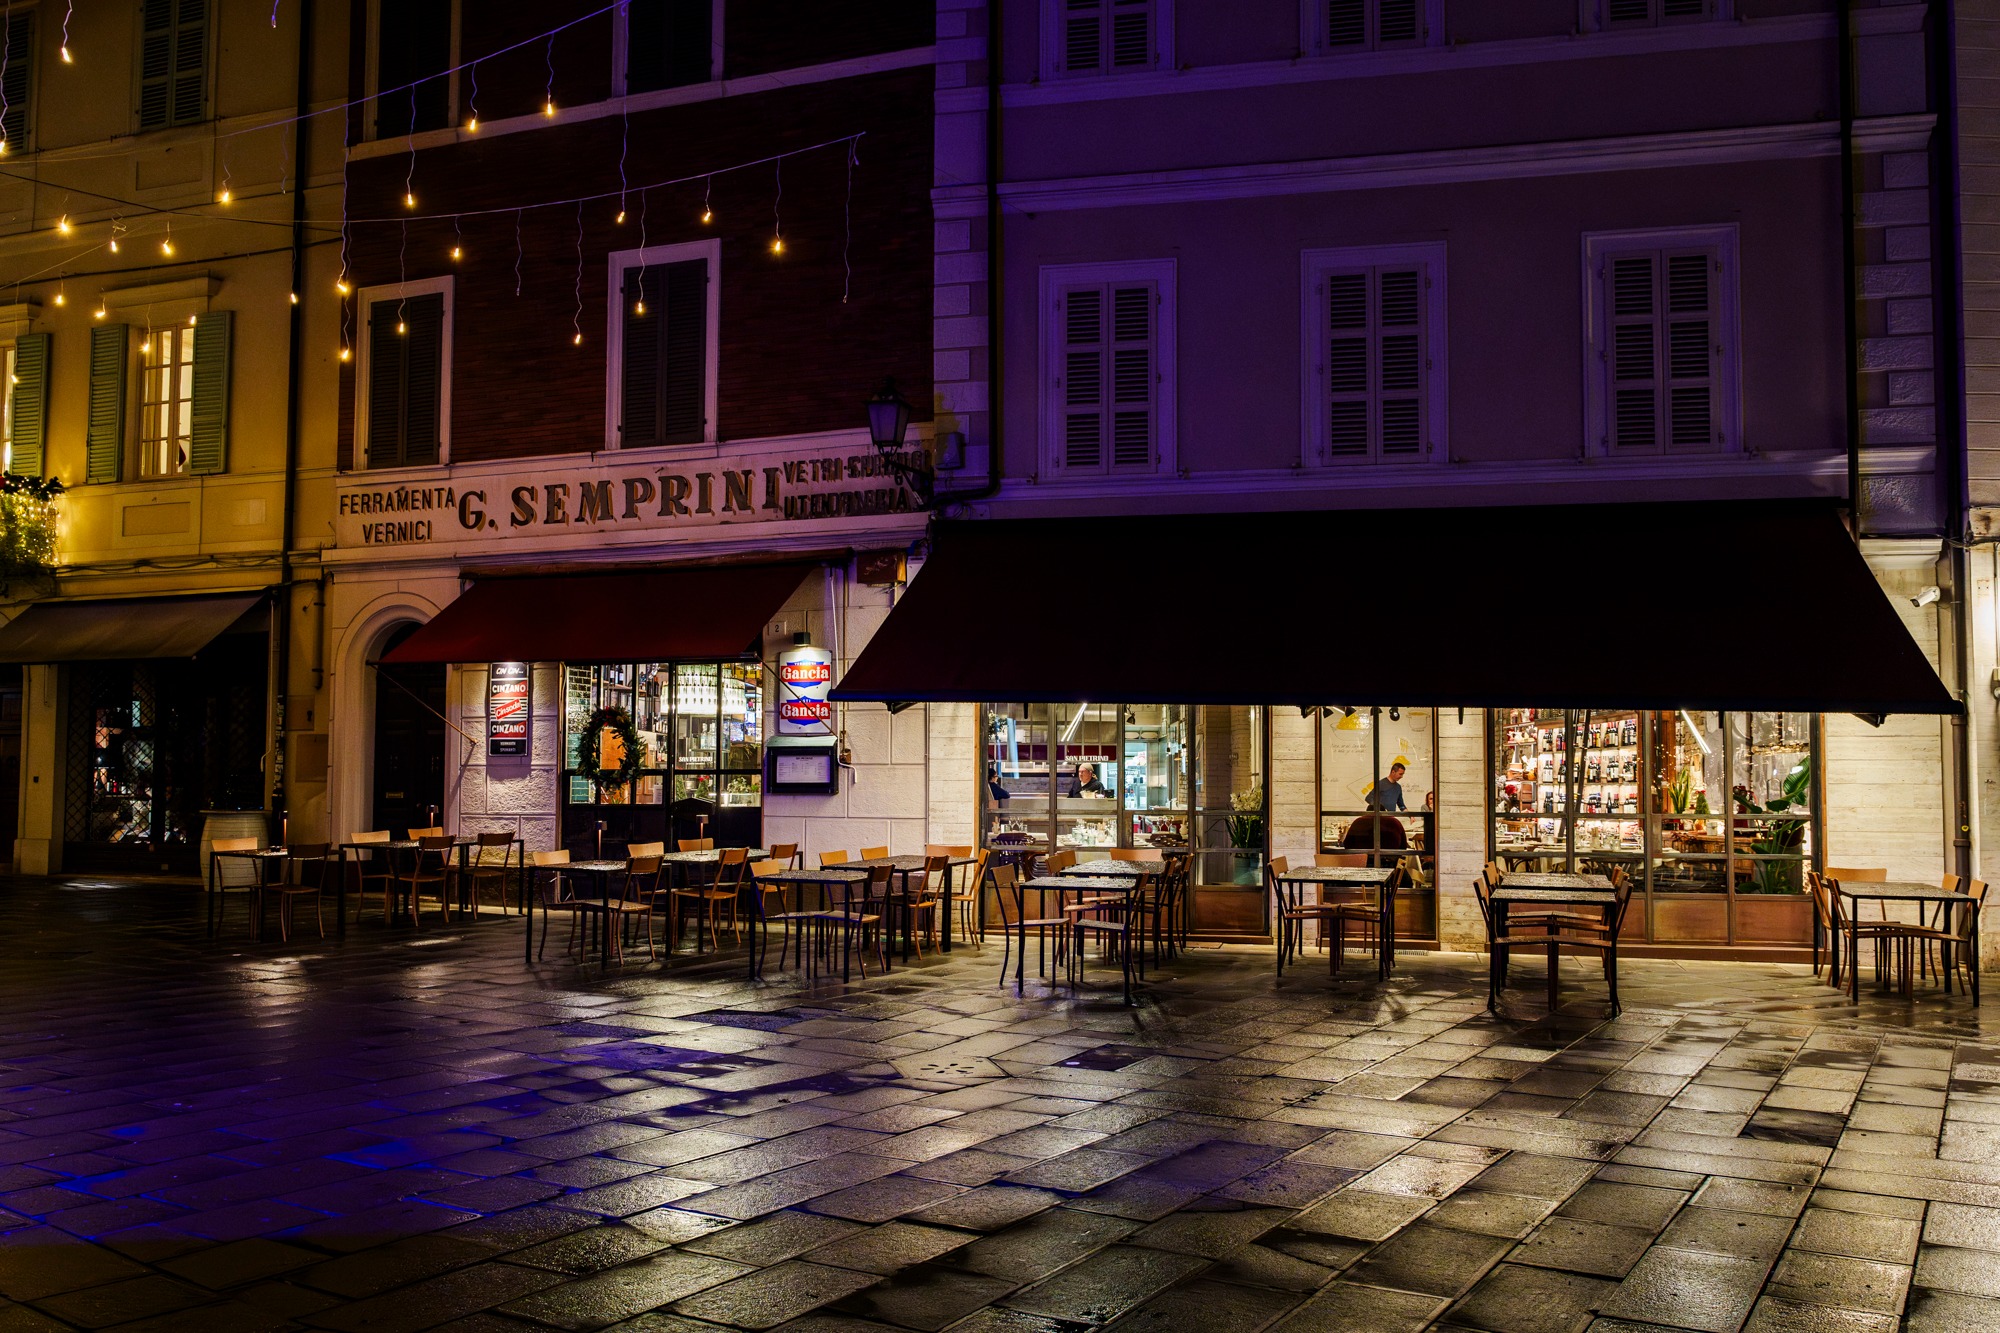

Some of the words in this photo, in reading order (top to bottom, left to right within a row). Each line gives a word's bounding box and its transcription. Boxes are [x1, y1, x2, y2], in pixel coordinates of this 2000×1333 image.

[339, 486, 456, 516] FERRAMENTA
[458, 490, 498, 531] G.
[510, 467, 782, 527] SEMPRINI
[362, 519, 432, 544] VERNICI
[774, 624, 780, 632] 2
[782, 666, 829, 680] Gancia
[492, 684, 526, 693] CINZANO
[782, 704, 829, 717] Gancia
[492, 724, 525, 734] CINZANO
